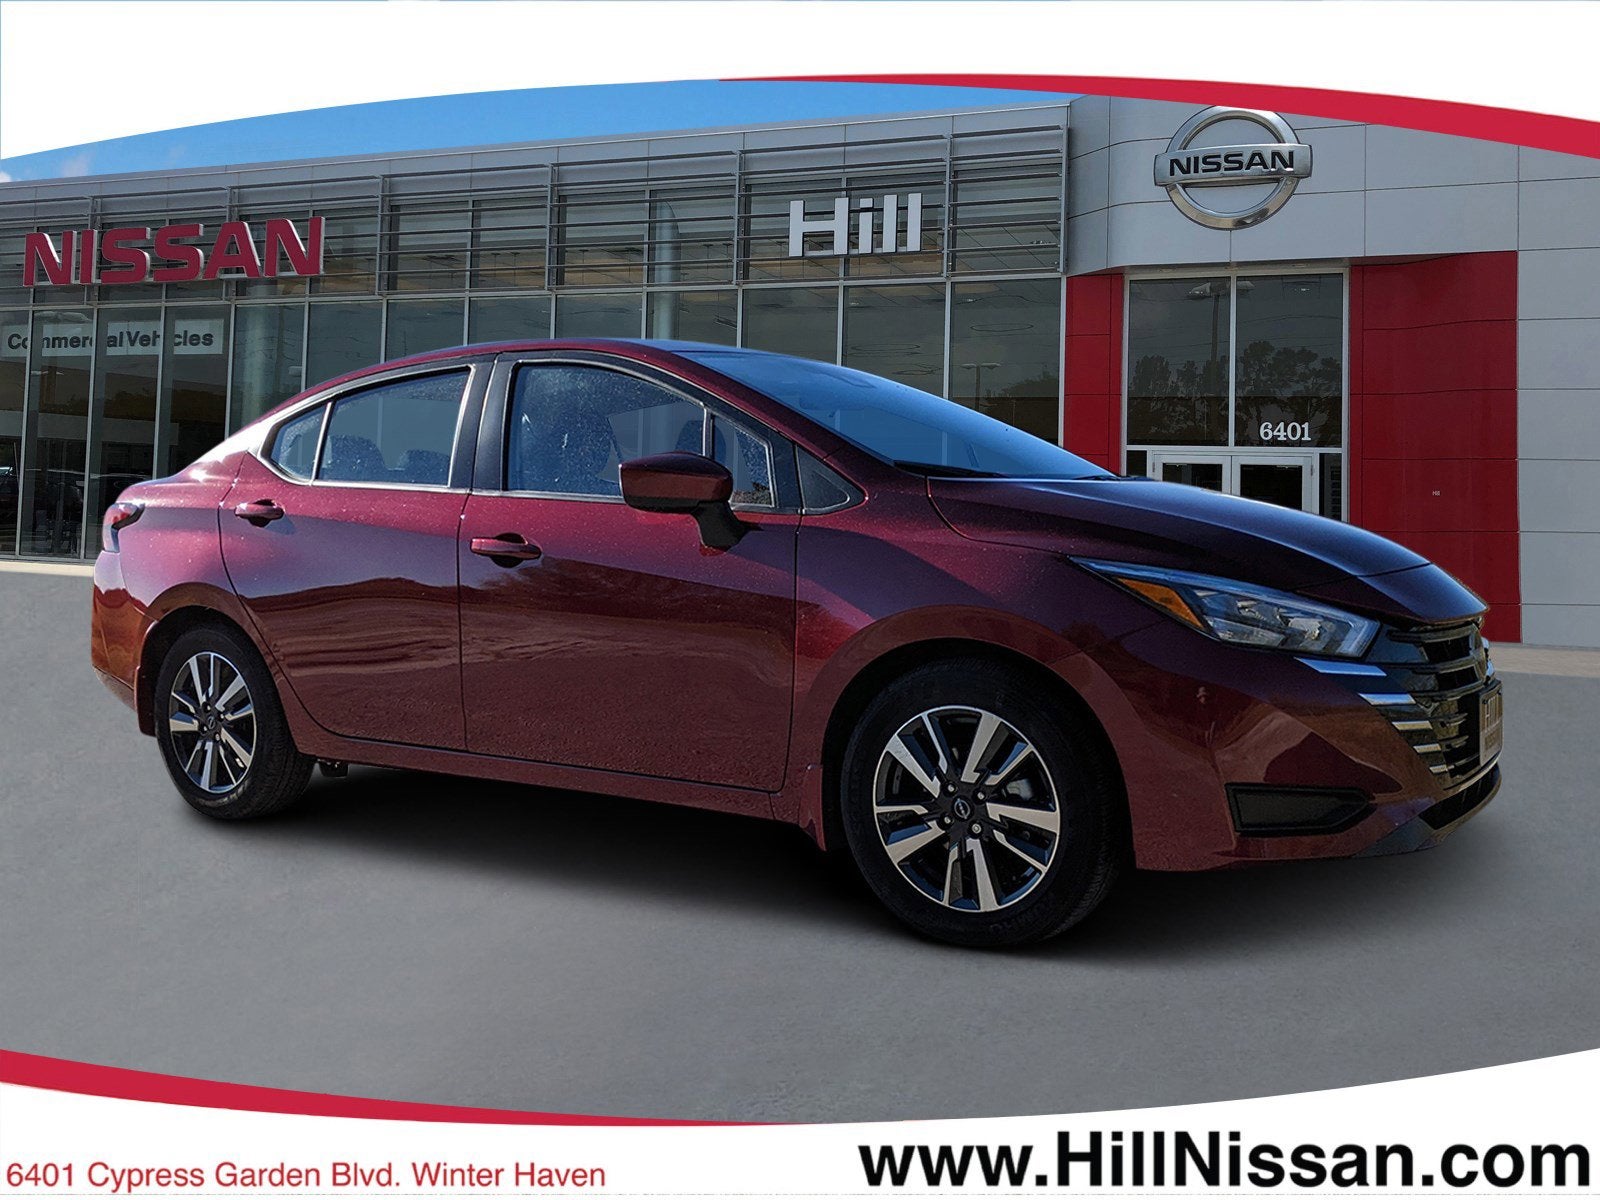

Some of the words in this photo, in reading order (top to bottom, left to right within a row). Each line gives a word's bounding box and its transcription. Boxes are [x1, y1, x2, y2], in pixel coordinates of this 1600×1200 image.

[1168, 150, 1295, 176] NISSAN
[788, 193, 922, 257] Hill
[23, 216, 325, 287] NISSAN
[7, 329, 123, 350] Commeral
[126, 329, 214, 348] Vehcles
[1259, 421, 1312, 441] 6401
